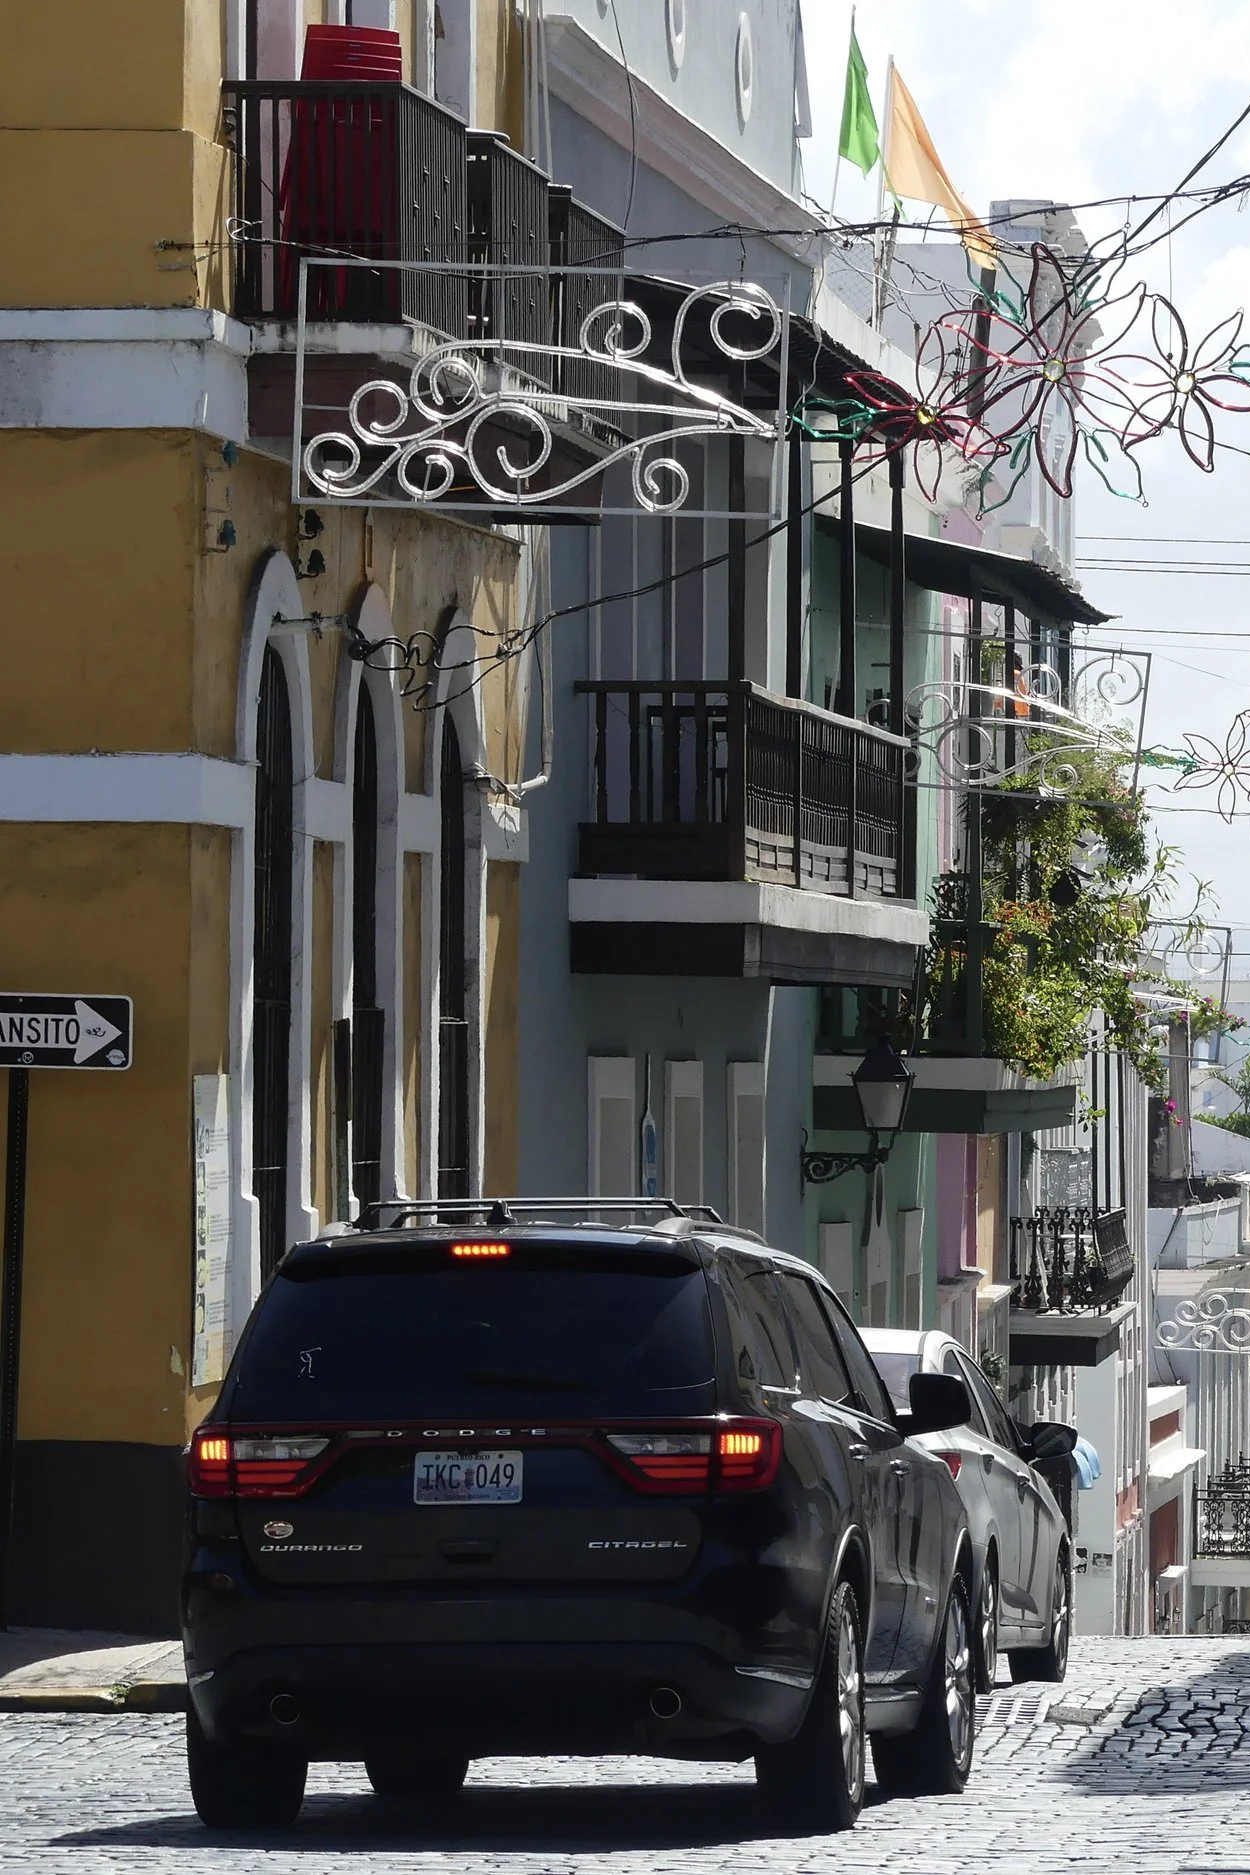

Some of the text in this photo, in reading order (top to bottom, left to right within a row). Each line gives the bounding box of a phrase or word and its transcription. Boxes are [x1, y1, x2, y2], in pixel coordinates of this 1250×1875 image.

[387, 1428, 546, 1438] DODGE
[422, 1463, 515, 1490] IKC 049
[259, 1544, 363, 1552] DURANGO
[588, 1540, 688, 1549] CITADEL
